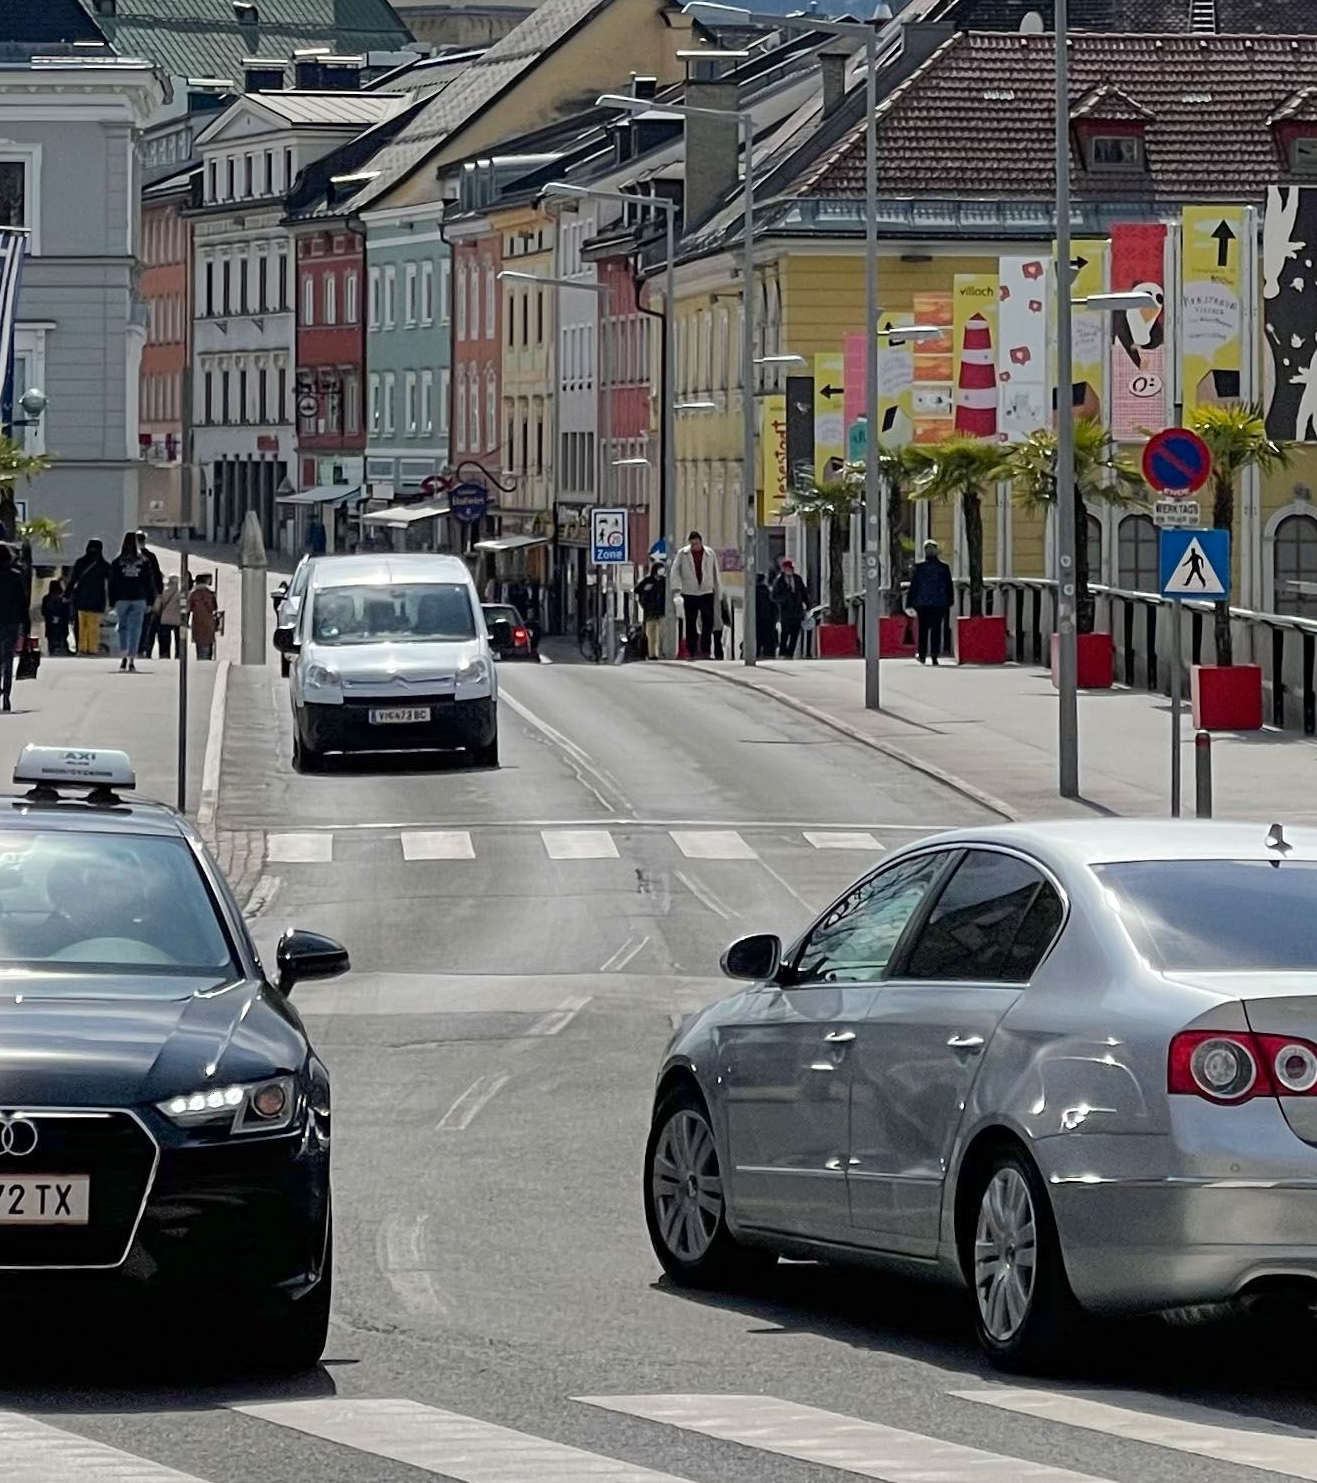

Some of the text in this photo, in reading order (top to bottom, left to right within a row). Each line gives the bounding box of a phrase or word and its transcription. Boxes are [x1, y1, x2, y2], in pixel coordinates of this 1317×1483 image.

[959, 285, 994, 297] villach
[1156, 503, 1199, 515] WERKTAGS
[597, 549, 623, 560] Zone
[59, 751, 97, 761] AXI
[35, 1184, 71, 1216] TX
